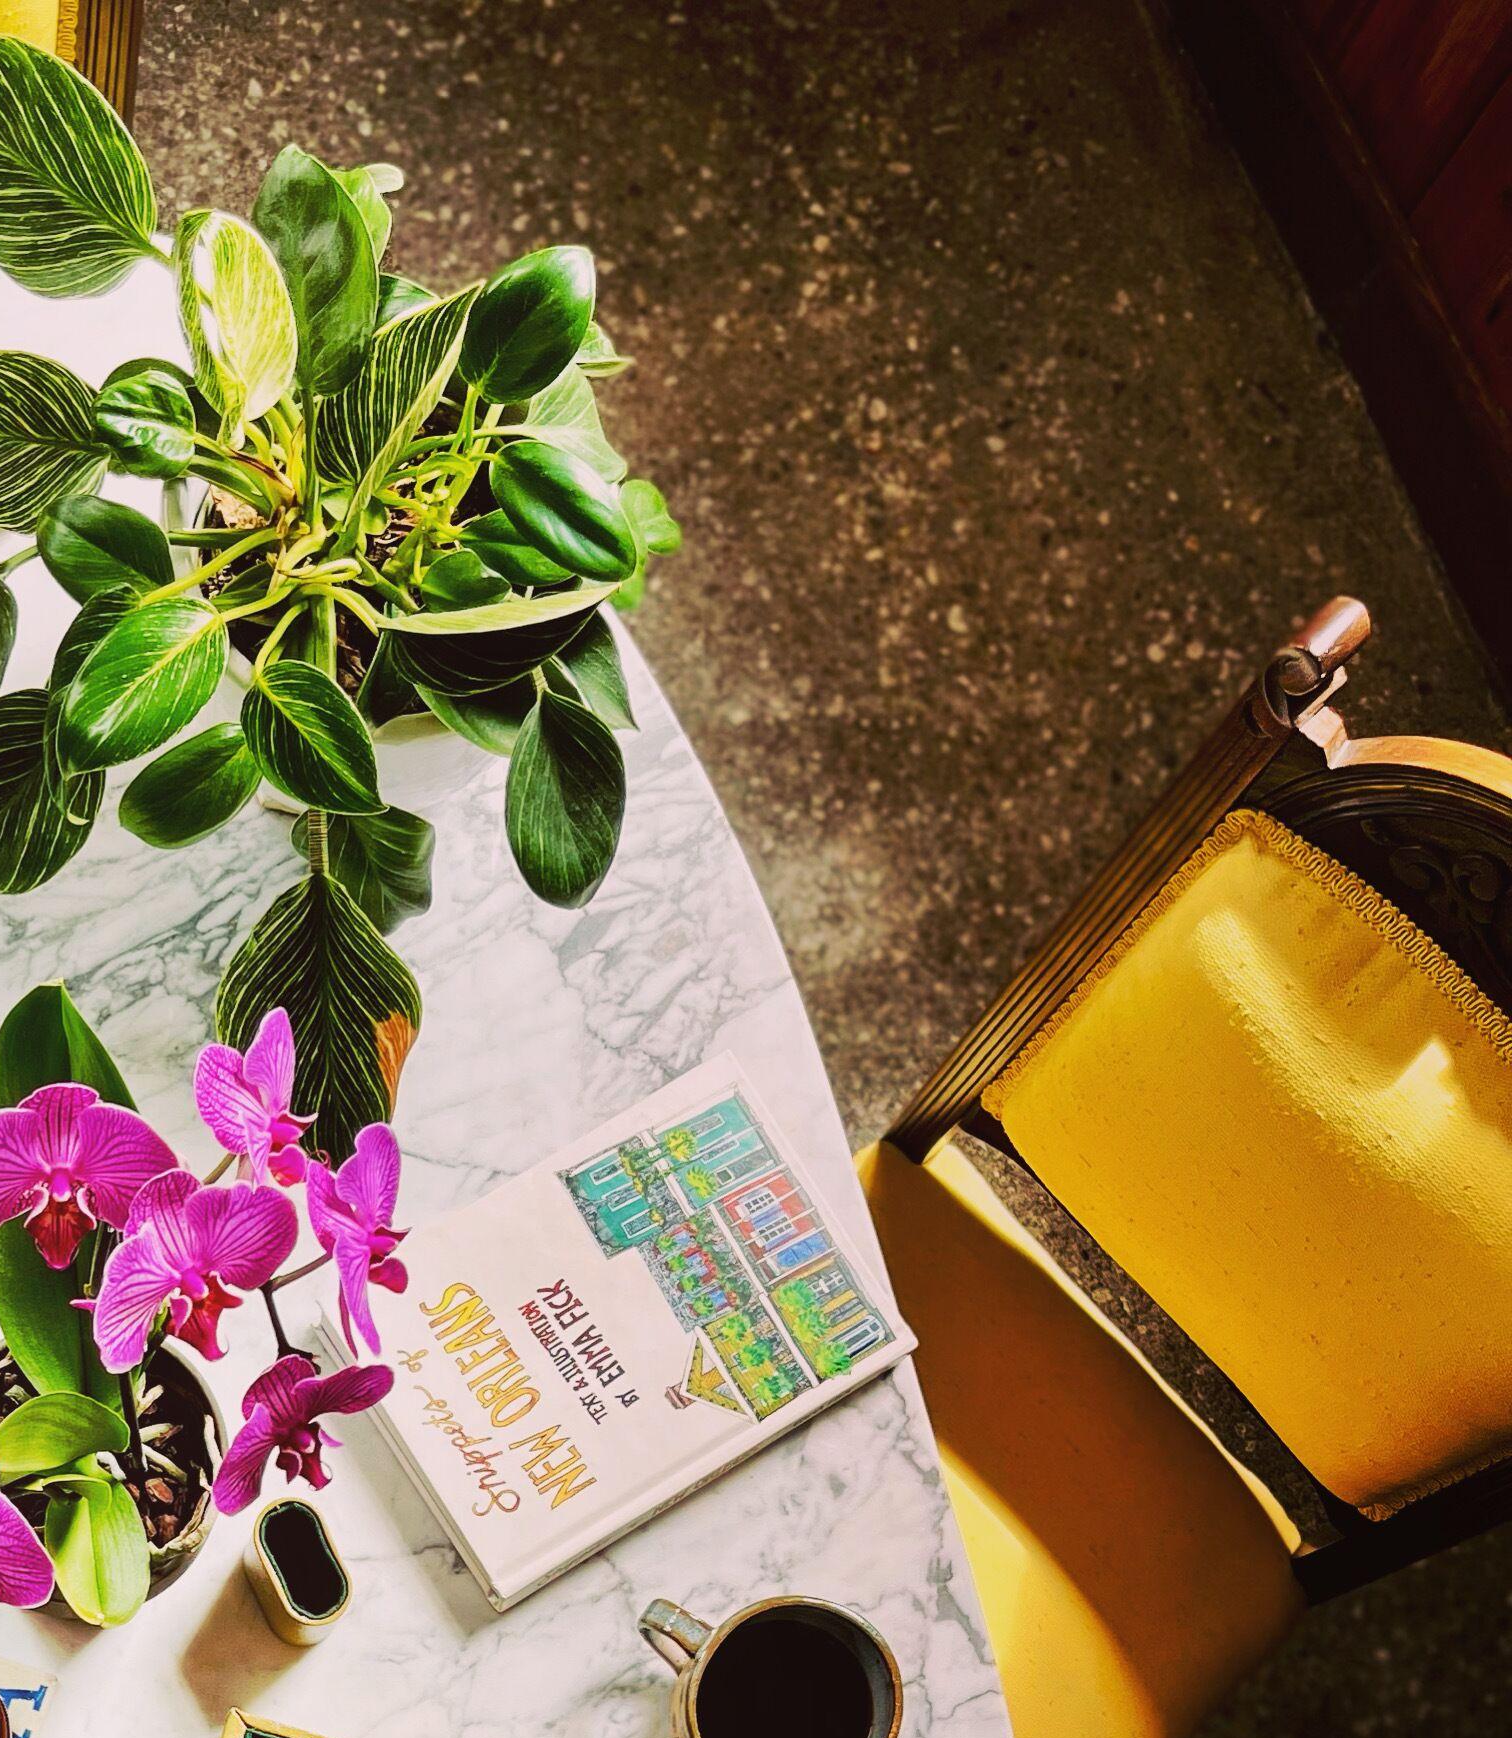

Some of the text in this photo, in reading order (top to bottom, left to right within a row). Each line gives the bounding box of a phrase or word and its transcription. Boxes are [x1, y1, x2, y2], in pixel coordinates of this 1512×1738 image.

[419, 1282, 598, 1511] NEW ORLEANS
[518, 1300, 609, 1425] TEXT & ILLUSTRATION
[537, 1278, 640, 1409] BY EMMA FICK
[397, 1349, 520, 1517] Snippets of
